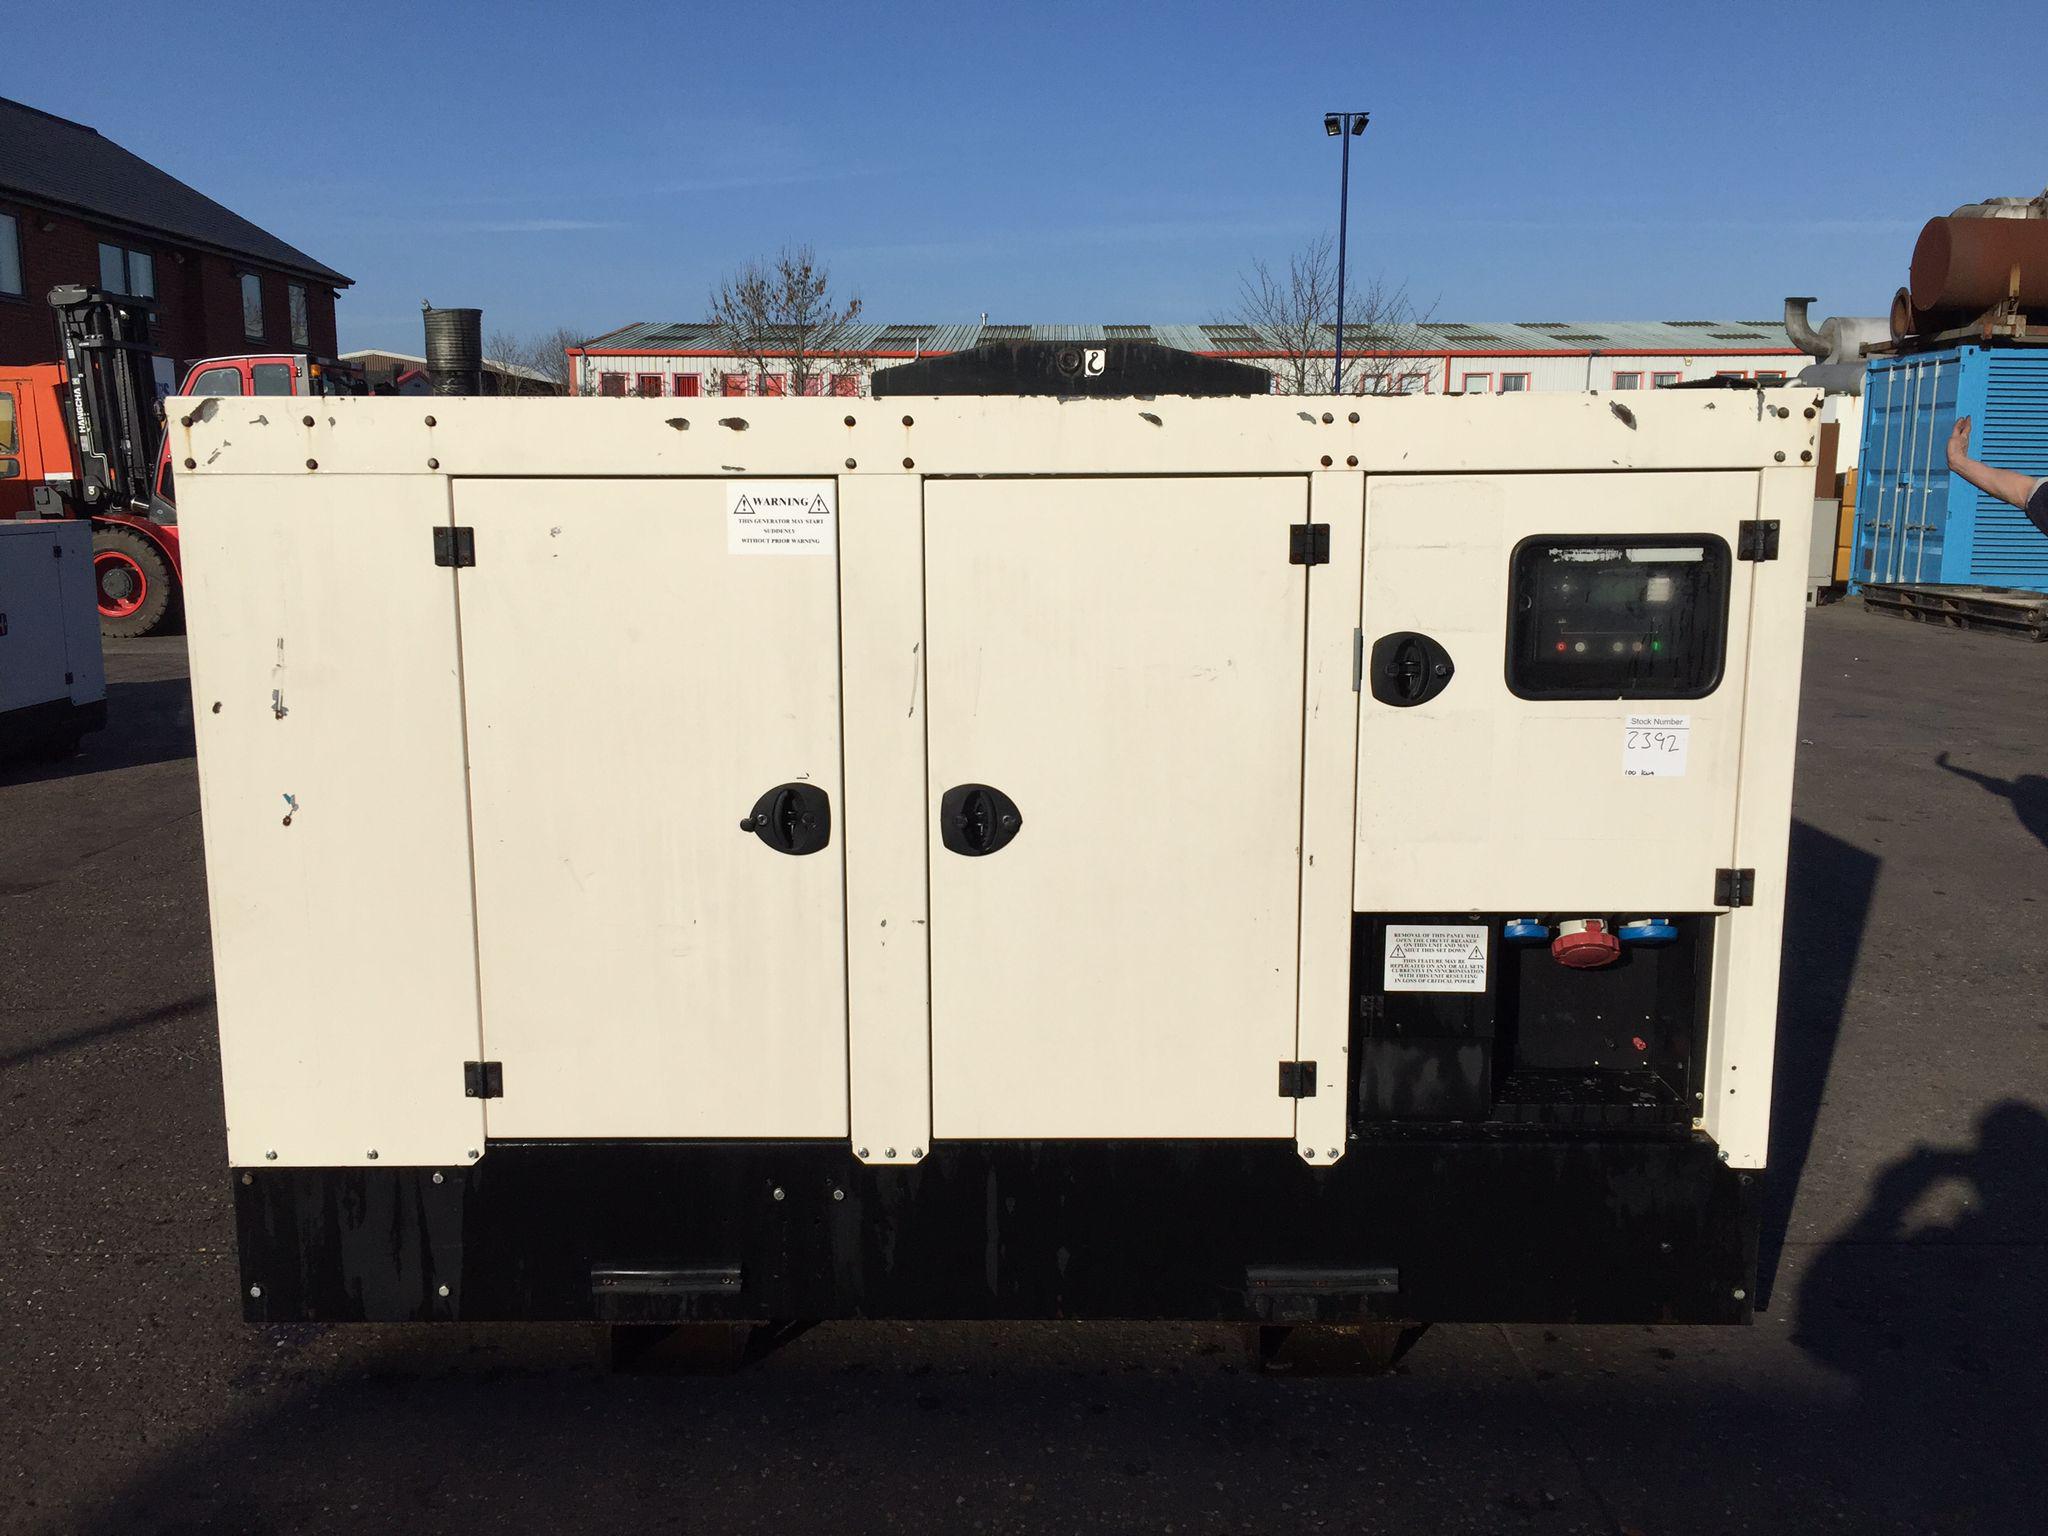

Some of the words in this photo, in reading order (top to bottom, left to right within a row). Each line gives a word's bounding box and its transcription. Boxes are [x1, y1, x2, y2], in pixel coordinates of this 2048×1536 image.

[74, 387, 86, 433] HANGCHA
[753, 497, 809, 506] WARNING
[1627, 731, 1679, 752] 2392
